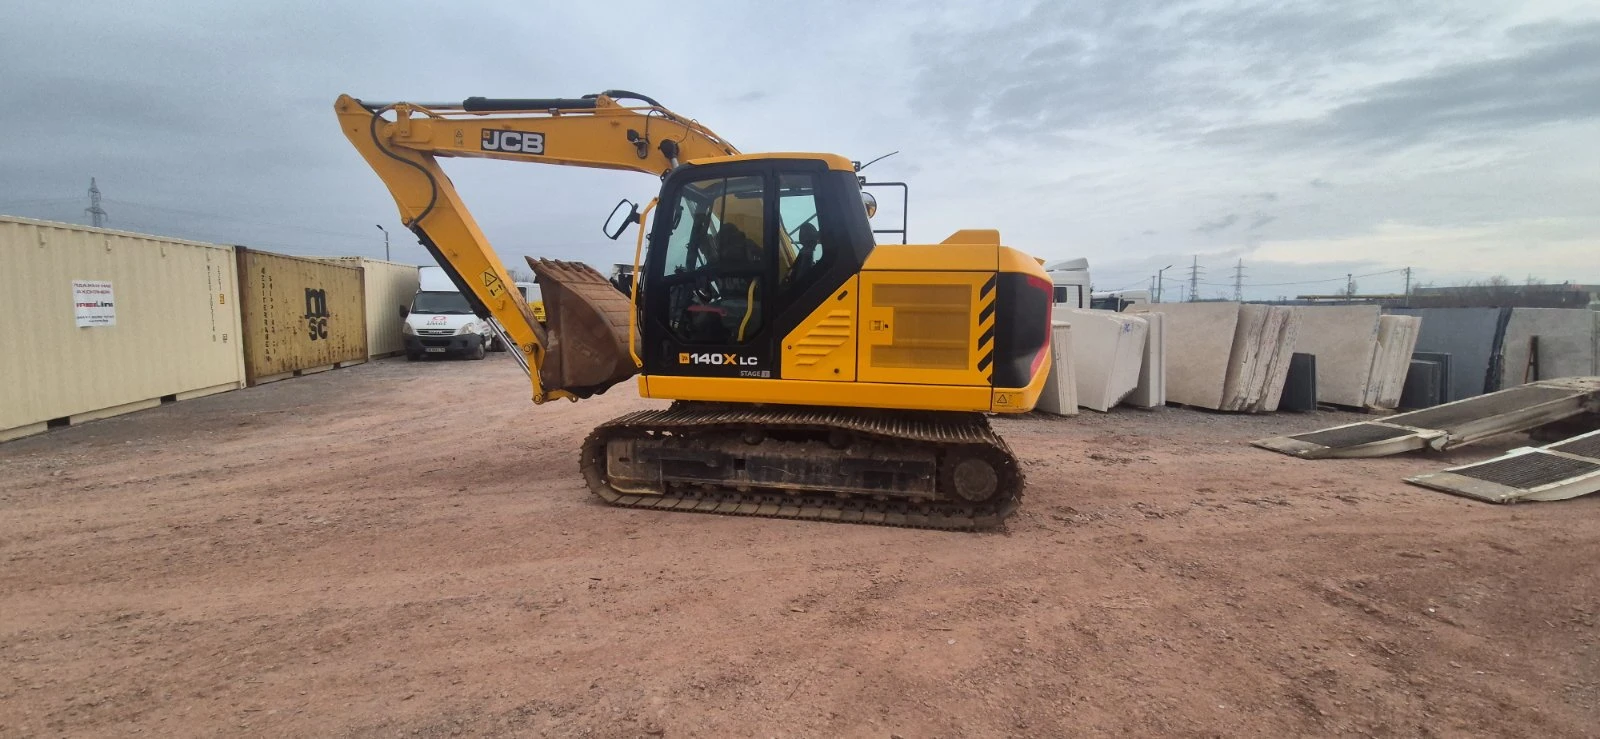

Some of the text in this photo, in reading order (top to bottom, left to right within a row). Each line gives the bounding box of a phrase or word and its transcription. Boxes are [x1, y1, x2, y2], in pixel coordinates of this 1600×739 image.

[482, 130, 544, 154] JCB
[690, 353, 758, 366] 140X LC
